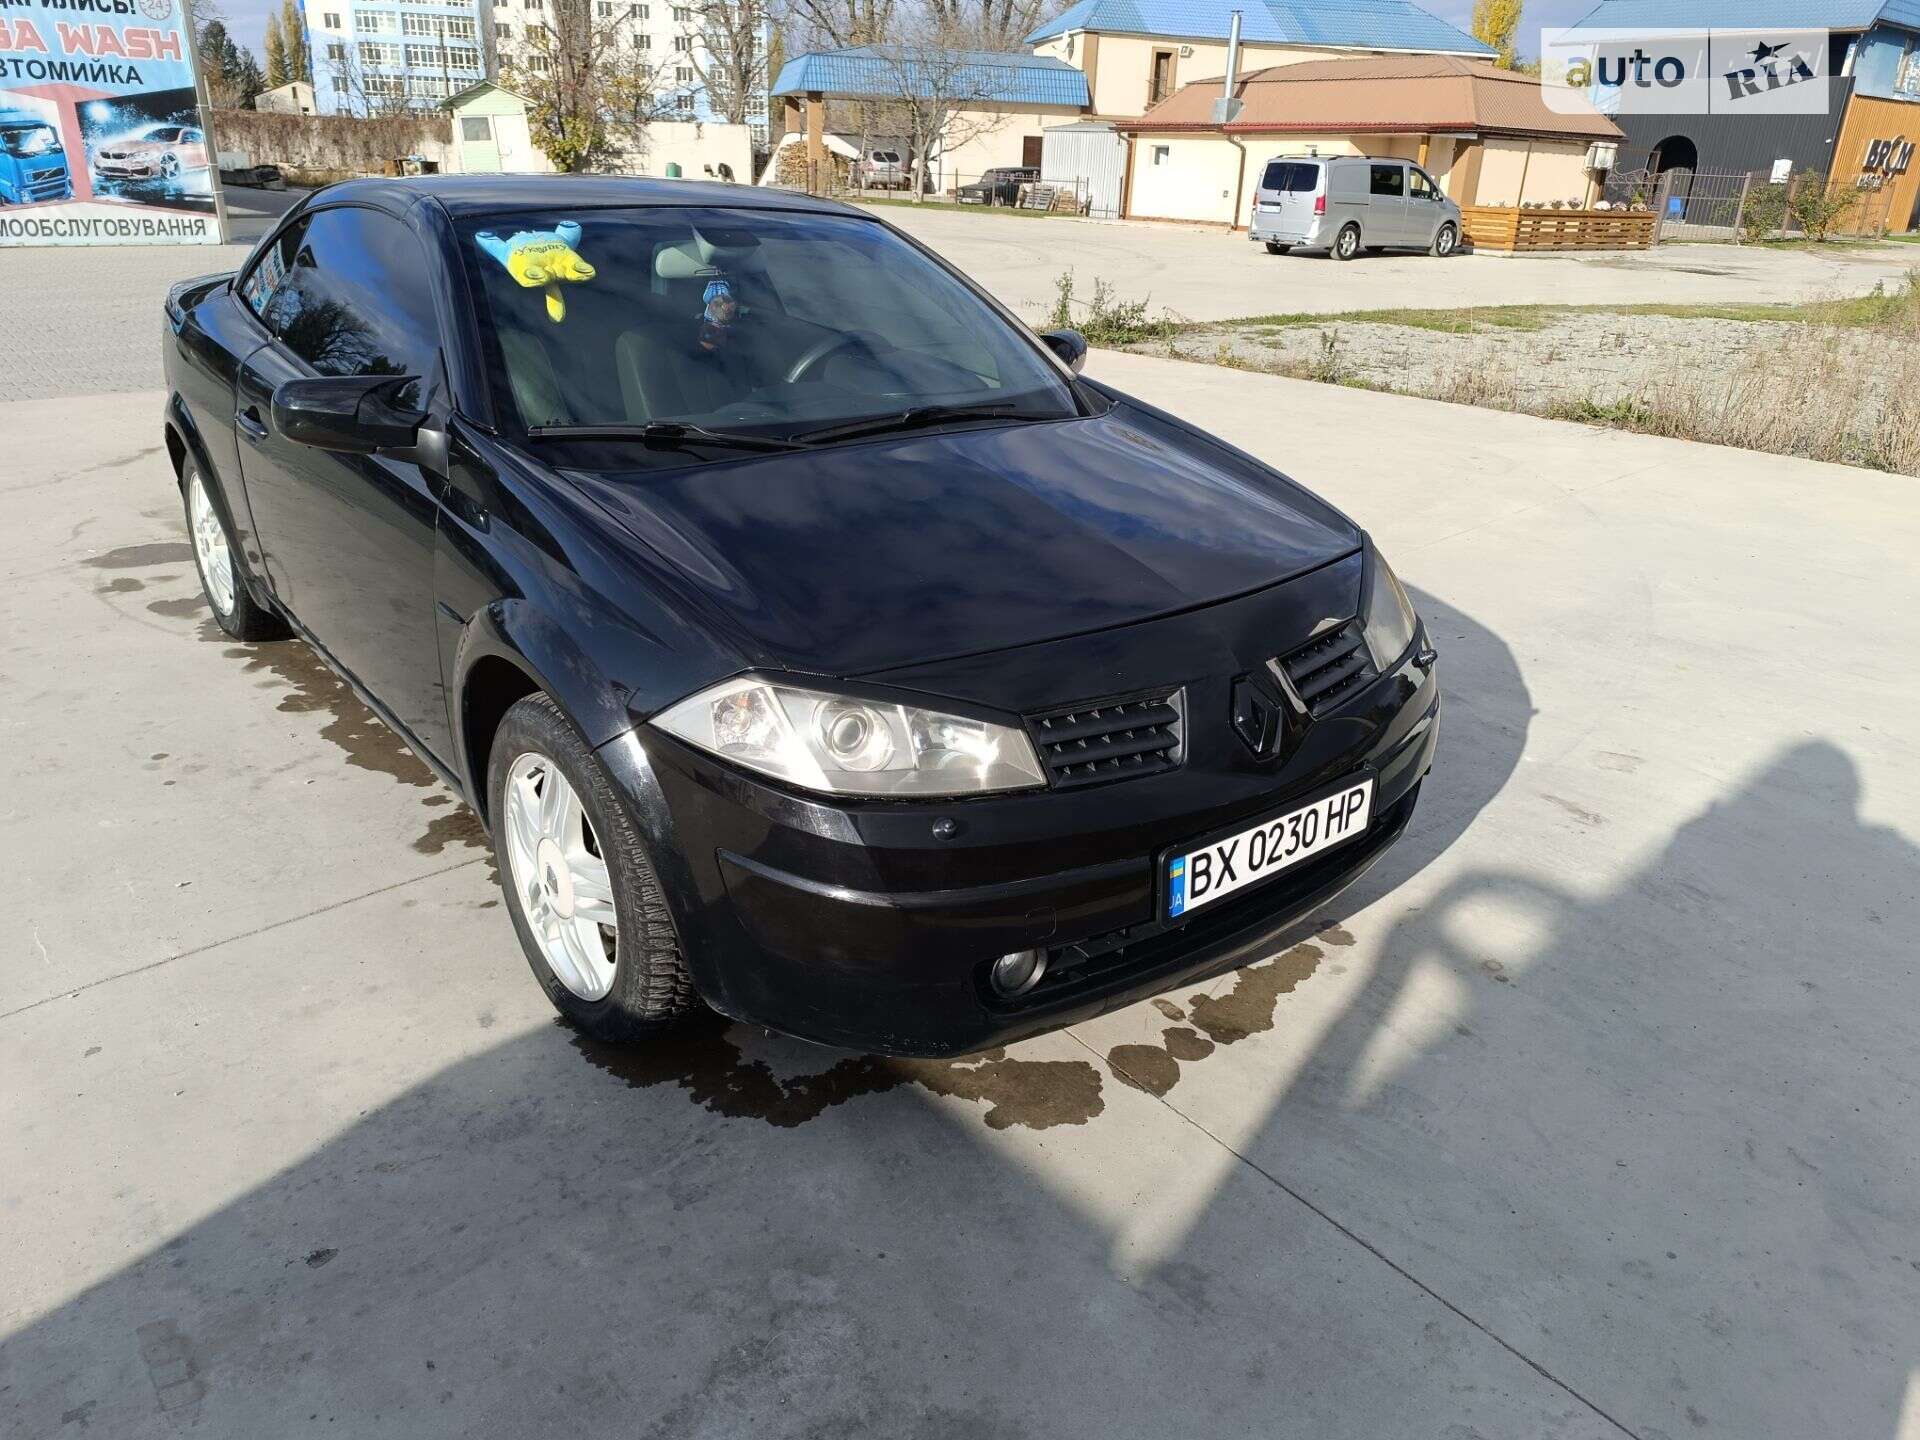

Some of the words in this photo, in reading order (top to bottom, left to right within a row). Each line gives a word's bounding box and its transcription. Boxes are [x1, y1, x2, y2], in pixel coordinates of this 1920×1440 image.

[57, 23, 182, 61] WASH
[1190, 839, 1240, 900] BX
[1248, 808, 1319, 873] 0230
[1324, 787, 1365, 840] HP
